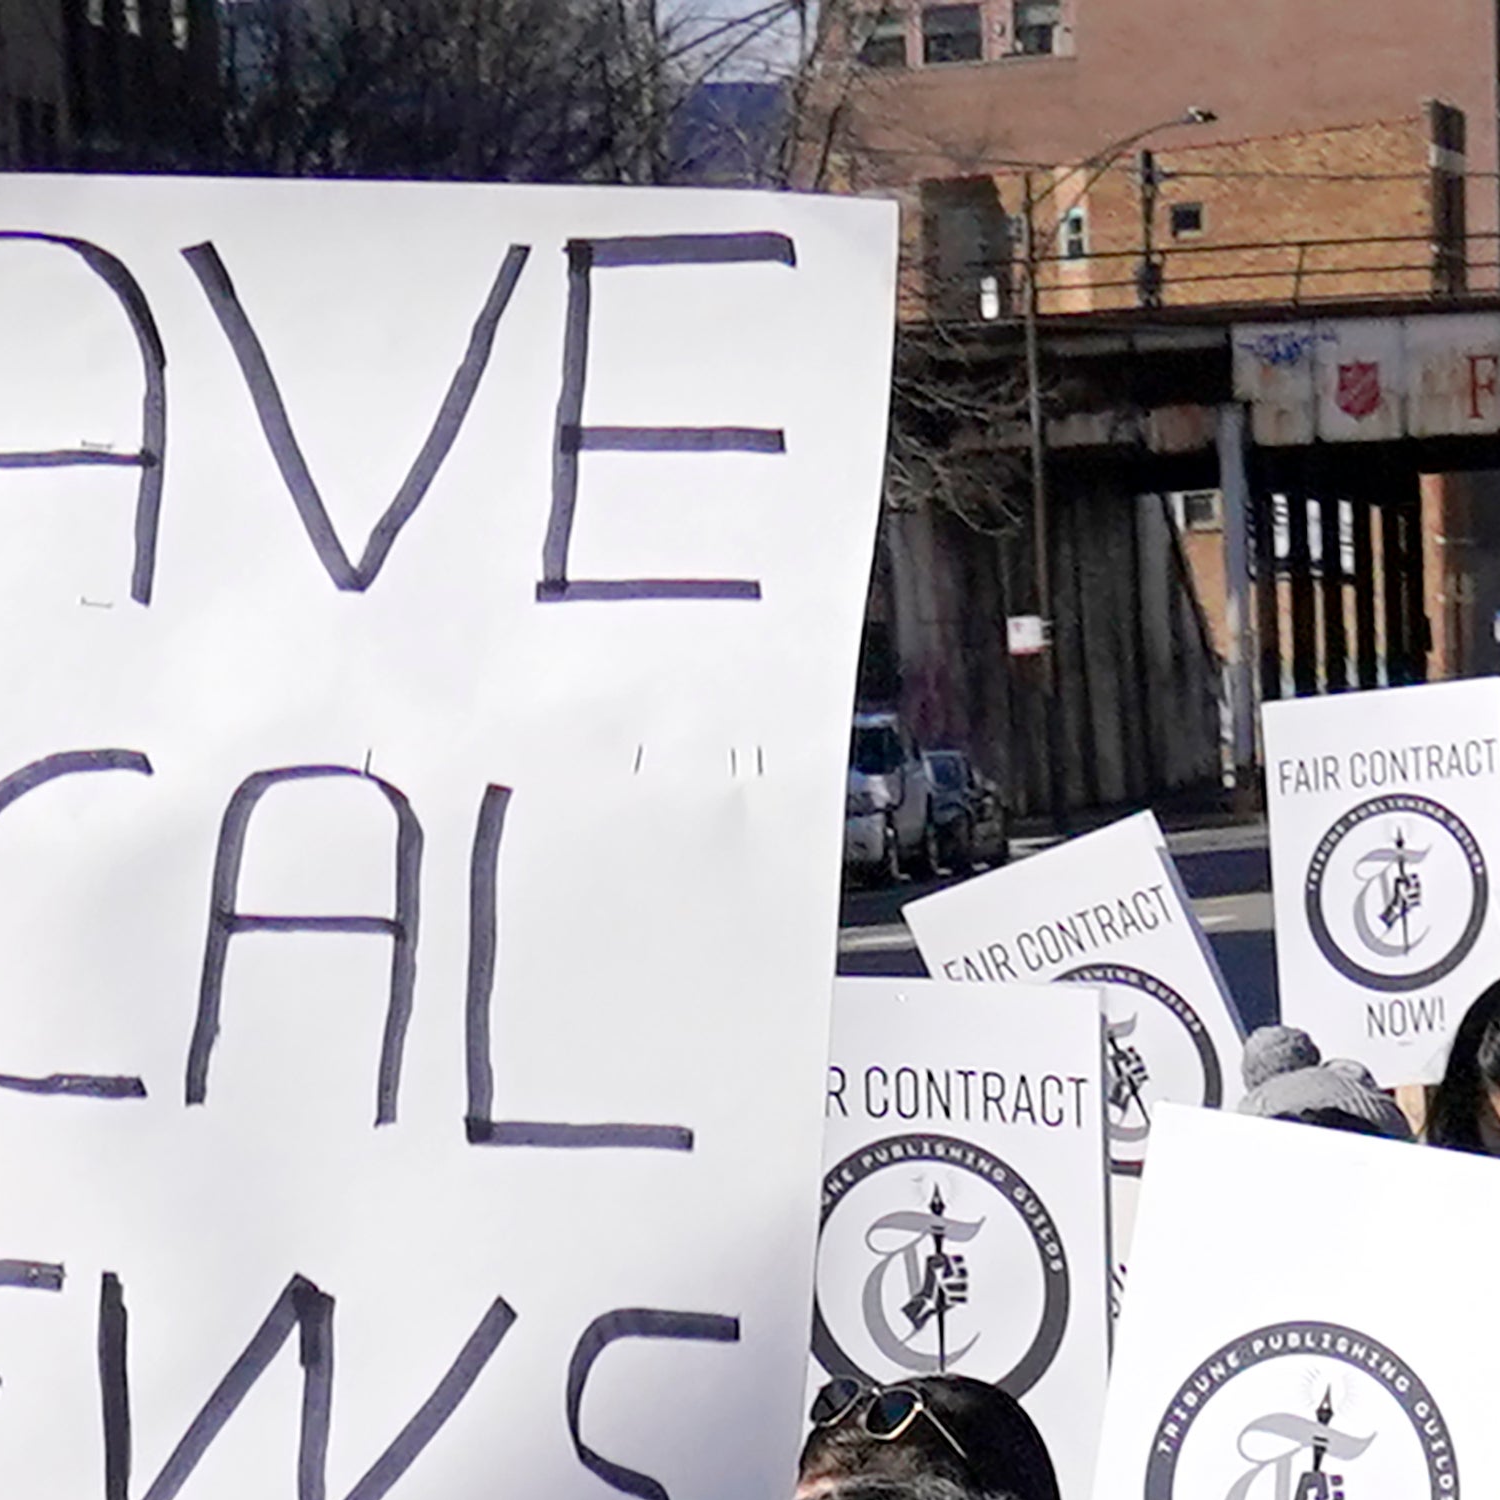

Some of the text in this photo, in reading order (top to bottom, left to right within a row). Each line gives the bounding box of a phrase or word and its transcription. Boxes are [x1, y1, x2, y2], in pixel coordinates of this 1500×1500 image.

[1277, 738, 1497, 797] FAIR CONTRACT
[942, 884, 1173, 983] FAIR CONTRACT
[1366, 994, 1446, 1039] NOW!
[864, 1065, 1089, 1128] CONTRACT
[861, 1141, 1008, 1184] PUBLISHING
[1156, 1348, 1242, 1457] TRIBUNE
[1252, 1330, 1413, 1394] PUBLISHING
